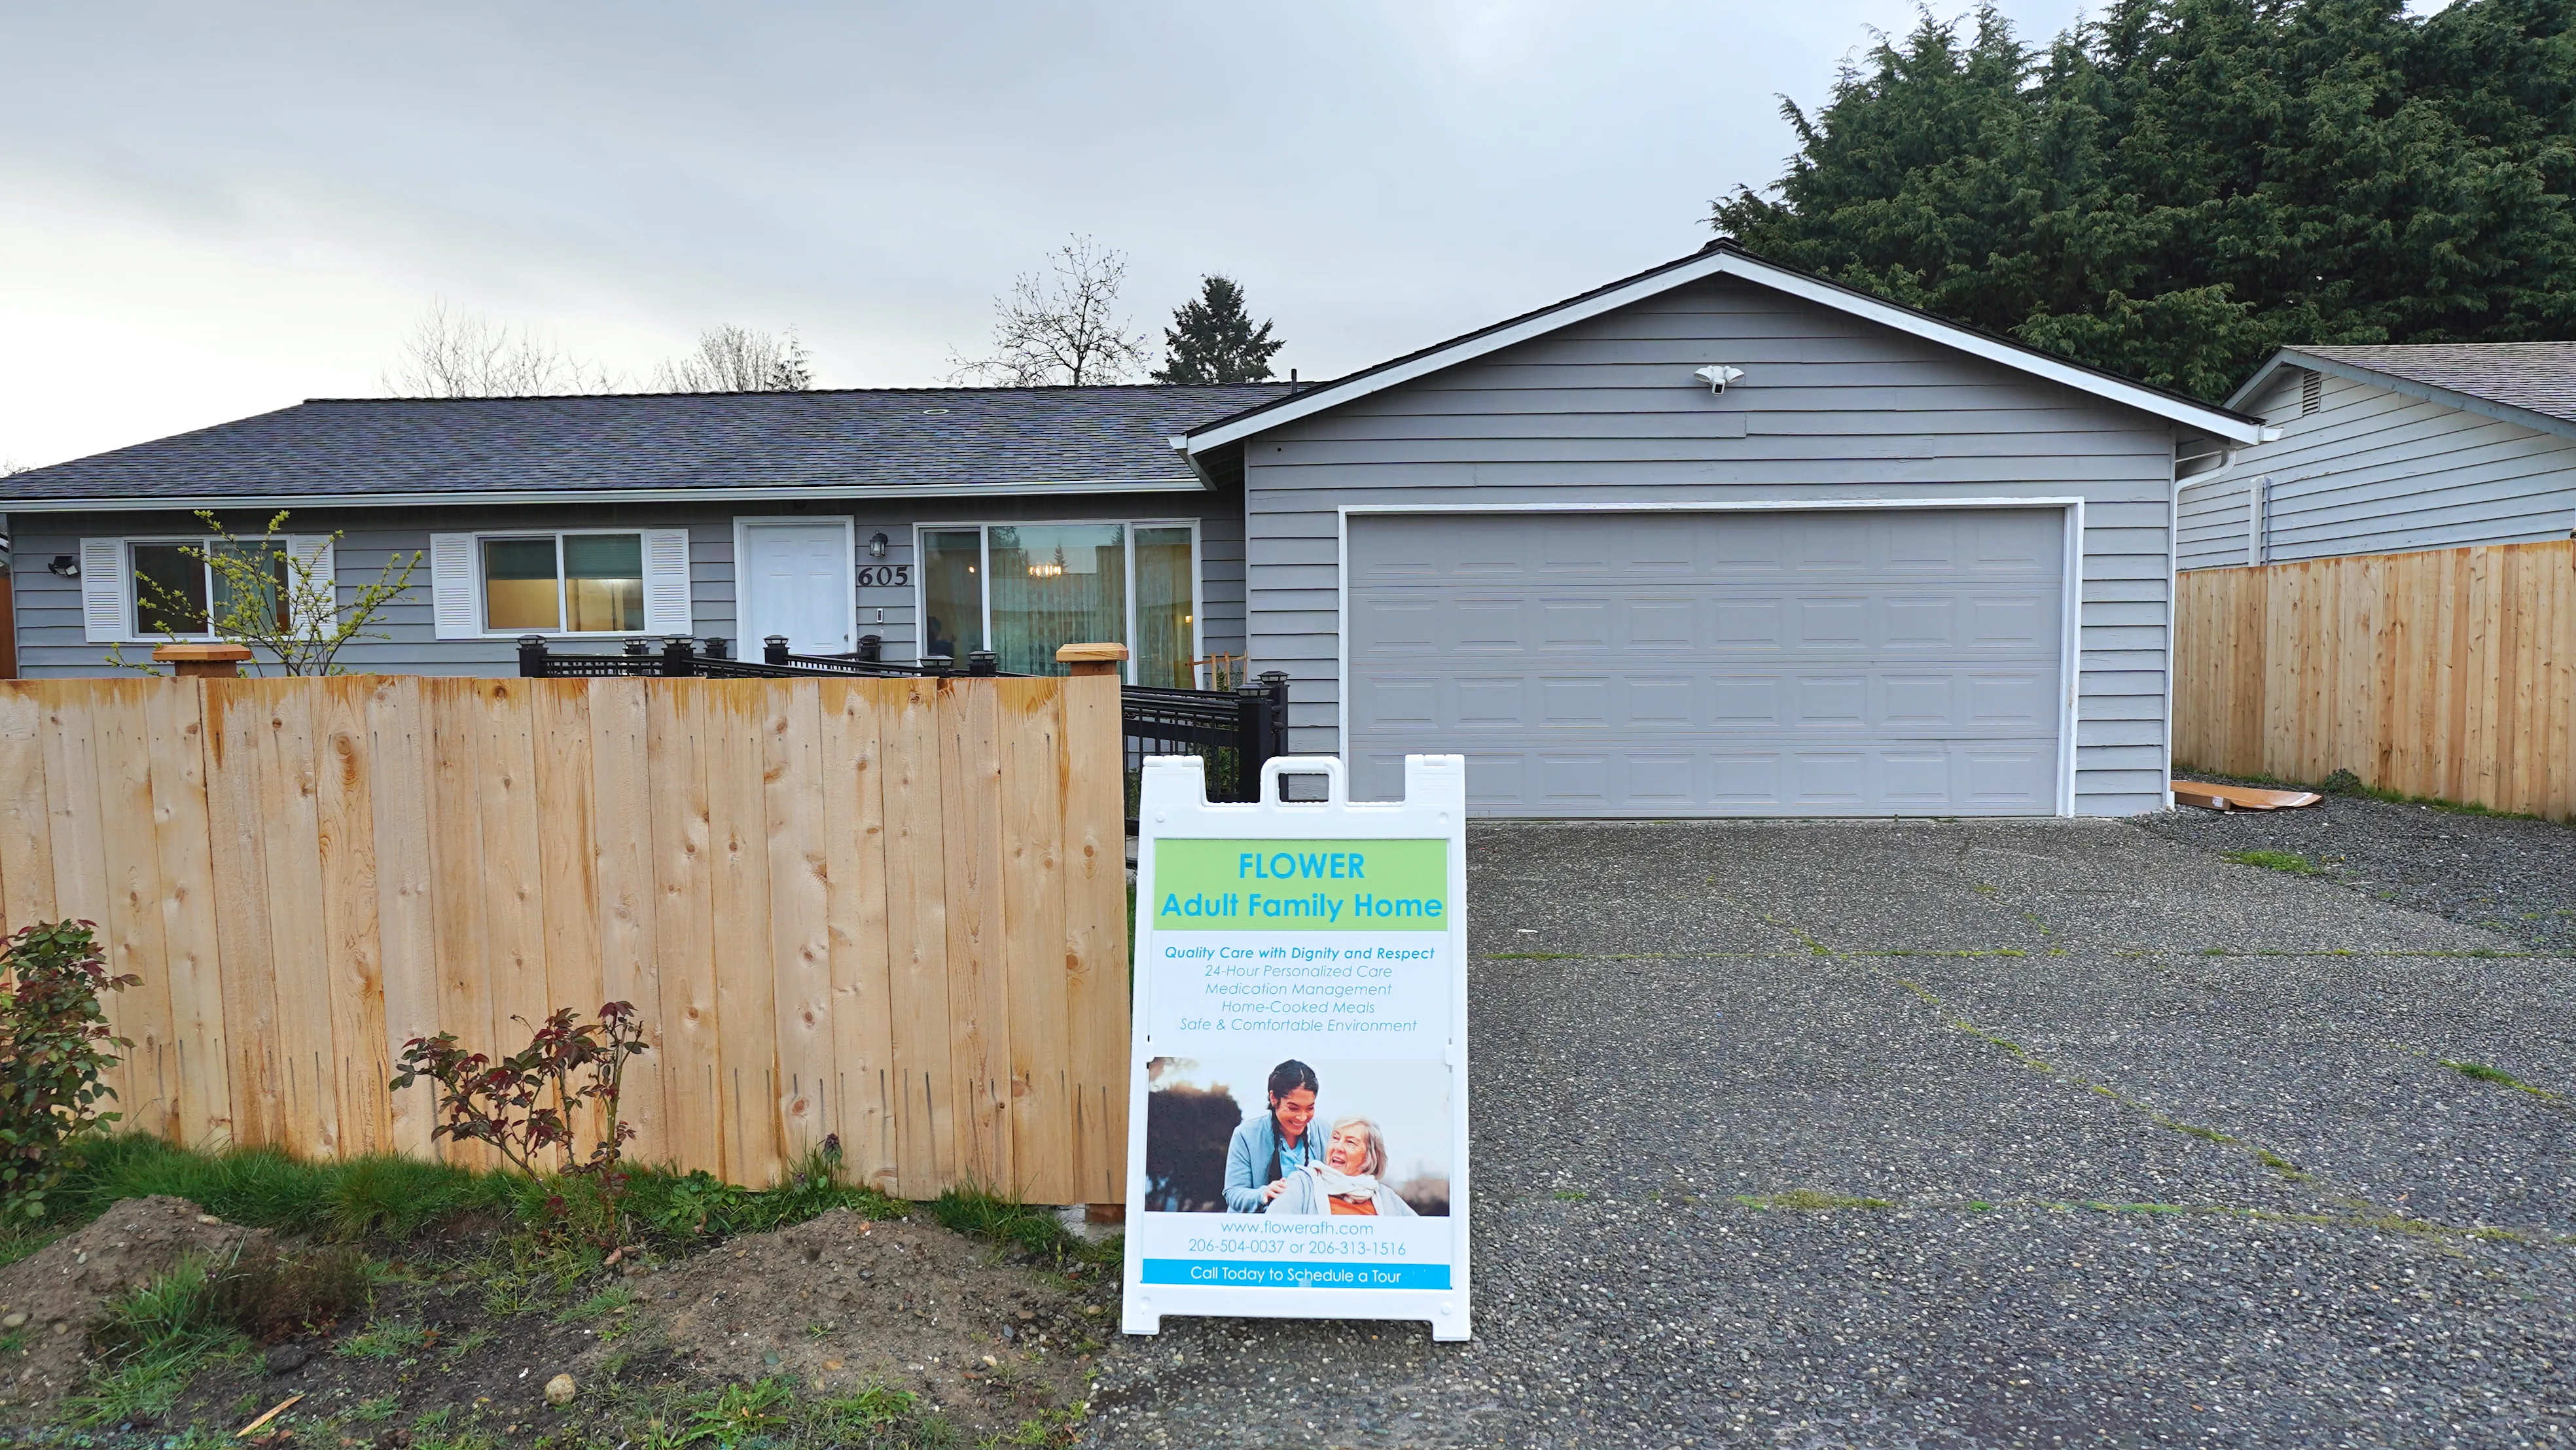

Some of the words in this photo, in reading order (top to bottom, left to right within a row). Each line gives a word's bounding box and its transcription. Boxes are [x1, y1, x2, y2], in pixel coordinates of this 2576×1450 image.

[858, 566, 908, 586] 605
[1240, 853, 1365, 879] FLOWER
[1161, 893, 1238, 916] Adult
[1249, 893, 1344, 923] Family
[1355, 894, 1442, 917] Home
[1166, 947, 1215, 960] Quality
[1220, 947, 1253, 958] Care
[1259, 947, 1286, 958] with
[1292, 947, 1339, 961] Dignity
[1344, 947, 1372, 959] and
[1378, 948, 1434, 961] Respect
[1205, 965, 1259, 976] 24-Hour
[1264, 965, 1352, 977] Personalized
[1357, 966, 1392, 977] Care
[1206, 983, 1287, 995] Medication
[1292, 984, 1392, 998] Management
[1223, 1001, 1328, 1013] Home-Cooked
[1333, 1002, 1374, 1013] Meals
[1181, 1018, 1211, 1030] Safe
[1217, 1019, 1226, 1030] &
[1232, 1019, 1322, 1031] Comfortable
[1328, 1019, 1417, 1031] Environment
[1221, 1220, 1373, 1235] www.flowerafh.com
[1189, 1239, 1284, 1253] 206-504-0037
[1290, 1244, 1304, 1253] or
[1310, 1241, 1405, 1255] 206-313-1516
[1191, 1266, 1218, 1279] Call
[1222, 1267, 1265, 1282] Today
[1270, 1268, 1283, 1281] to
[1287, 1268, 1353, 1282] Schedule
[1358, 1273, 1368, 1282] a
[1372, 1270, 1401, 1282] Tour
